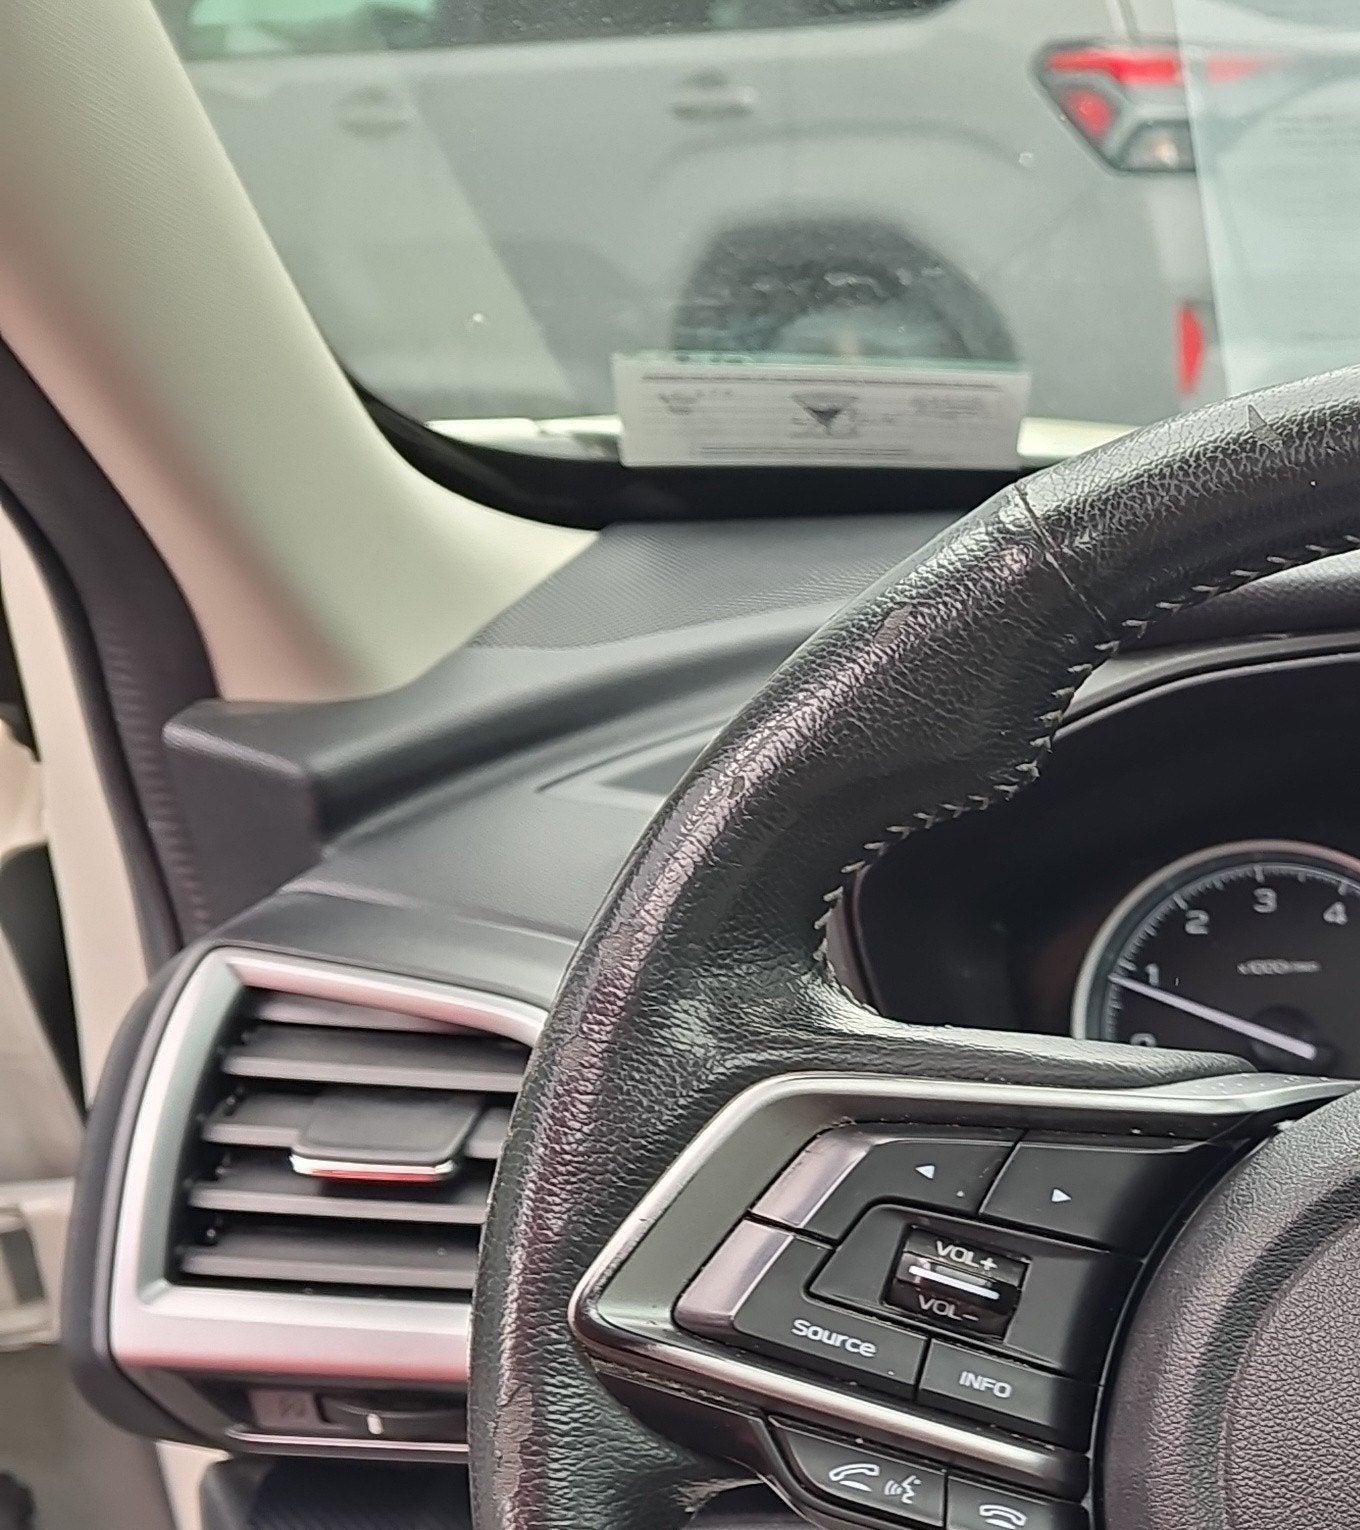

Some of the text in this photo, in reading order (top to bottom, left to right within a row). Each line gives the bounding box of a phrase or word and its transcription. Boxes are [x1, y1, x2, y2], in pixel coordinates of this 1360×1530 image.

[1252, 887, 1278, 914] 3
[1322, 901, 1348, 926] 4
[1184, 909, 1210, 936] 2
[1145, 963, 1160, 987] 1
[790, 1317, 878, 1359] Source
[958, 1370, 1013, 1399] INFO
